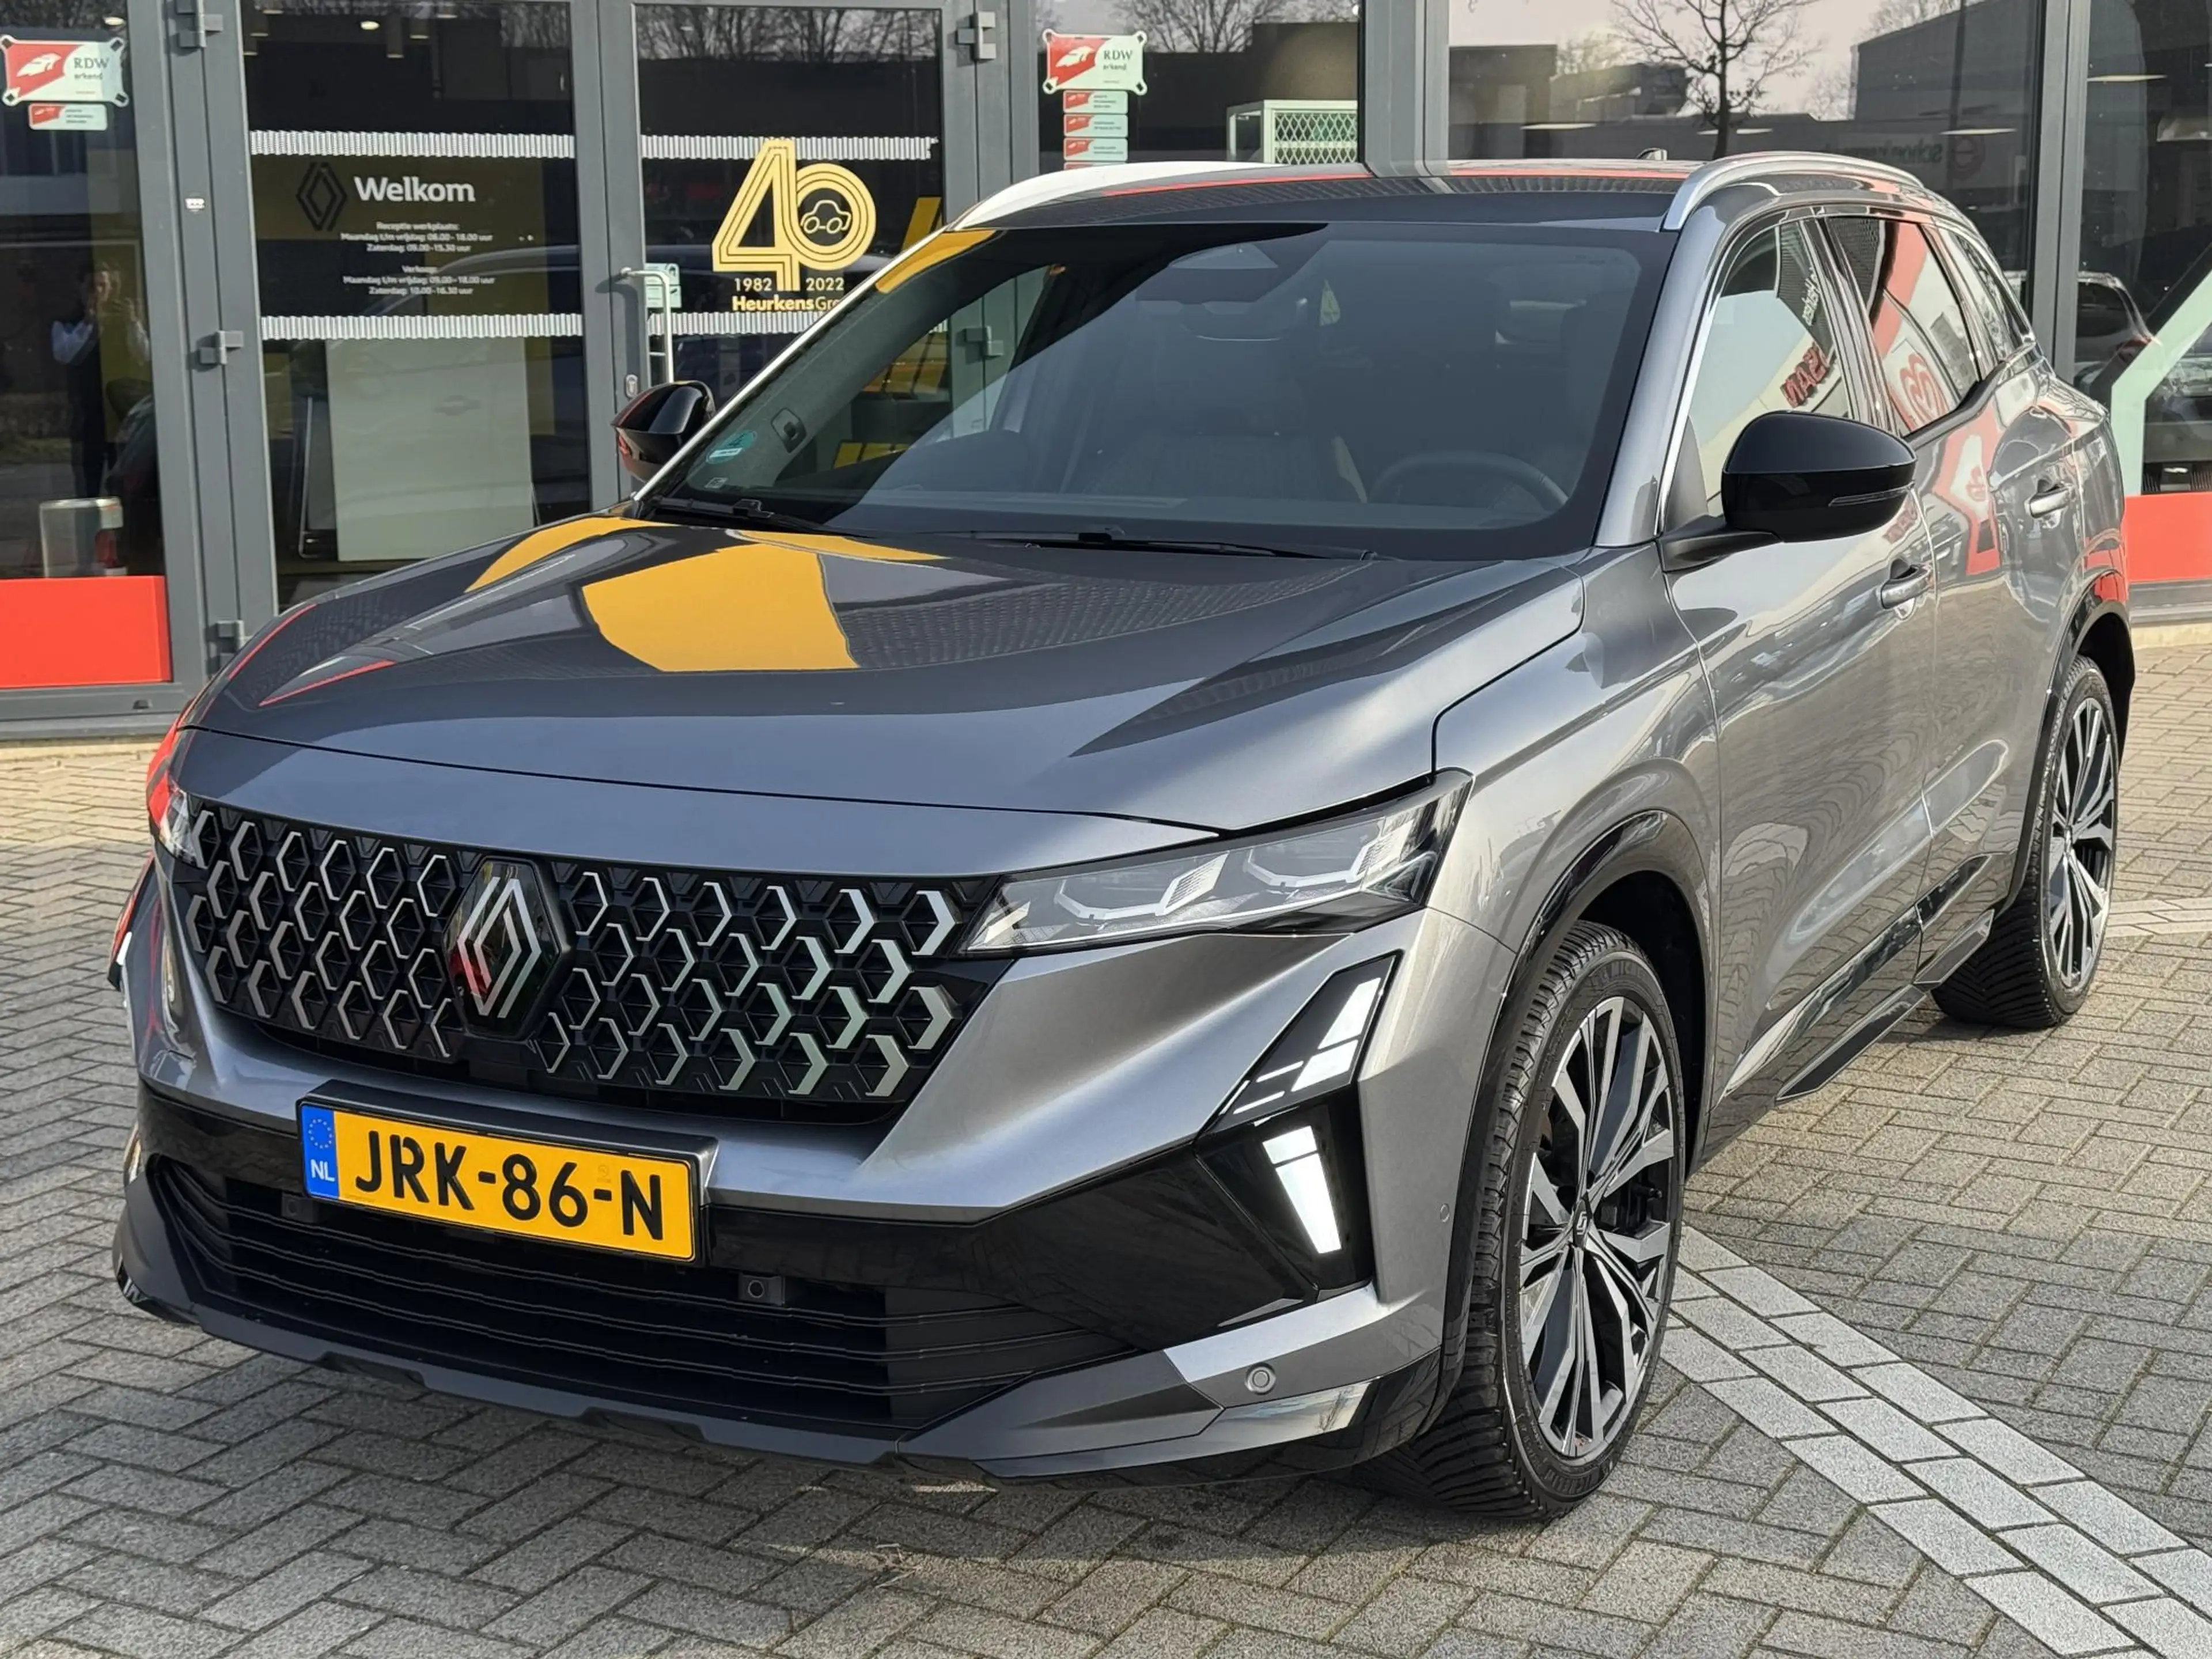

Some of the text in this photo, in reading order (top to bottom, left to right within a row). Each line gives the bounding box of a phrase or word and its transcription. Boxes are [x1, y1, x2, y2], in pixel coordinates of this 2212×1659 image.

[74, 57, 110, 69] RDW
[1103, 50, 1132, 60] RDW
[354, 176, 476, 202] Welkom
[711, 137, 877, 291] 40
[734, 277, 844, 291] 1982 2022
[310, 1158, 335, 1182] NL
[355, 1130, 664, 1241] JRK-86-N
